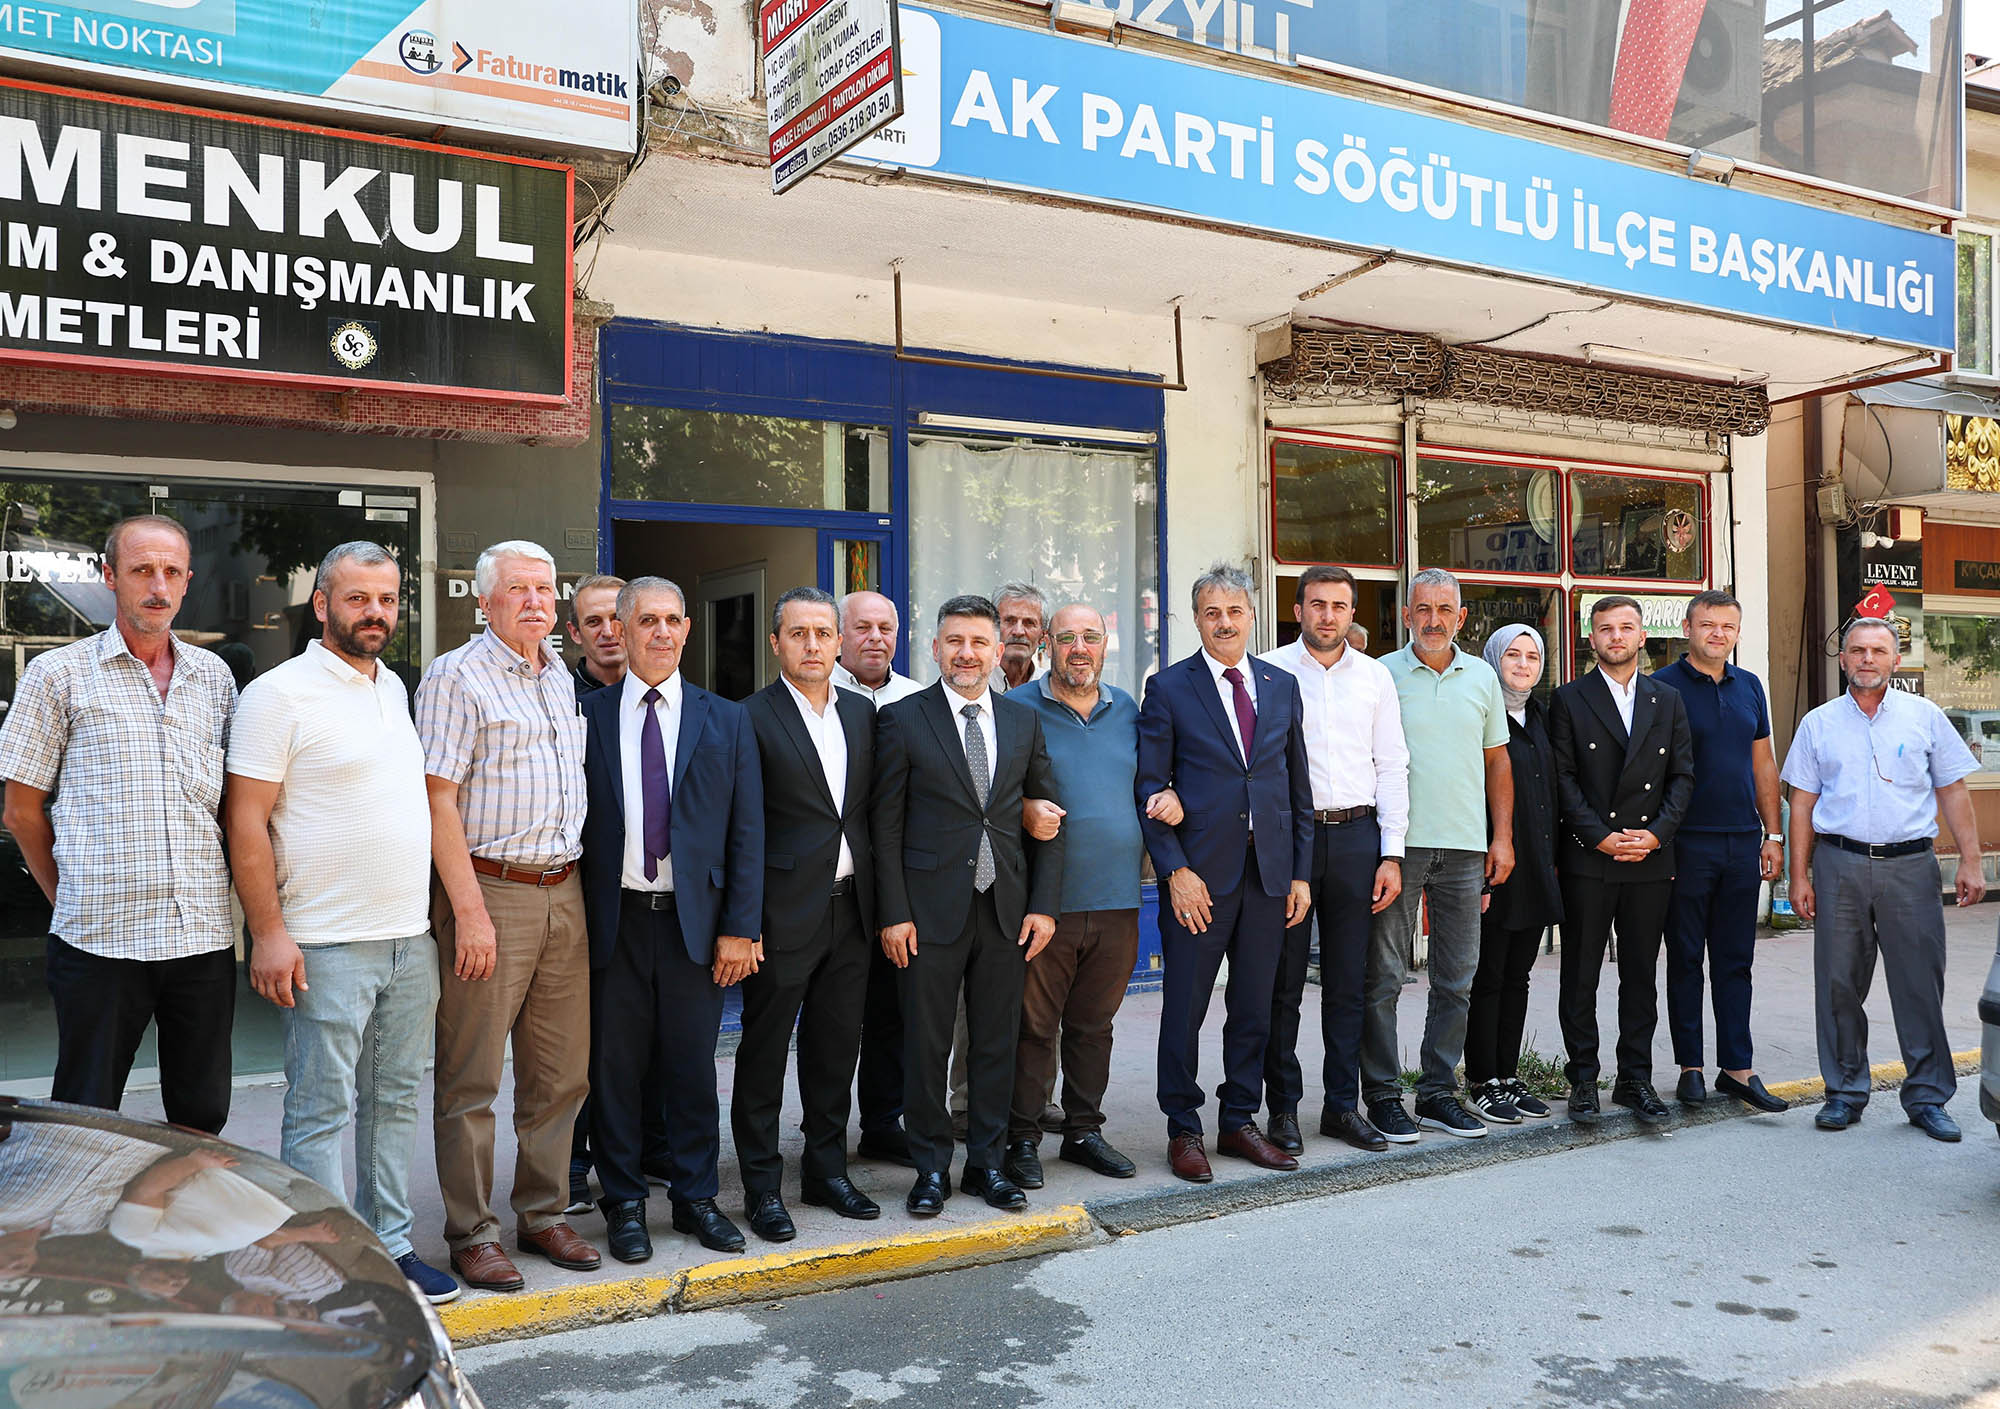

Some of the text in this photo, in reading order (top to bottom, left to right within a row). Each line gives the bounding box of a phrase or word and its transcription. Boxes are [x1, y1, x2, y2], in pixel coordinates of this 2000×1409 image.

[73, 16, 223, 67] NOKTASI
[819, 24, 884, 92] ÇORAP ÇEŞİTLERİ
[833, 19, 860, 49] YUMAK
[477, 48, 628, 99] Faturamatik
[772, 131, 795, 156] CENAZE
[832, 77, 867, 113] PANTOLON
[866, 56, 889, 87] DİKİMİ
[827, 122, 848, 148] 0536
[849, 109, 865, 134] 218
[866, 101, 877, 122] 30
[879, 92, 890, 114] 50
[873, 127, 906, 144] ARTi
[0, 115, 534, 264] MENKUL
[951, 69, 1934, 317] AK PARTİ SÖĞÜTLÜ İLÇE BAŞKANLIĞI
[82, 232, 128, 279] &
[150, 239, 536, 323] DANIŞMANLIK
[1867, 563, 1917, 580] LEVENT
